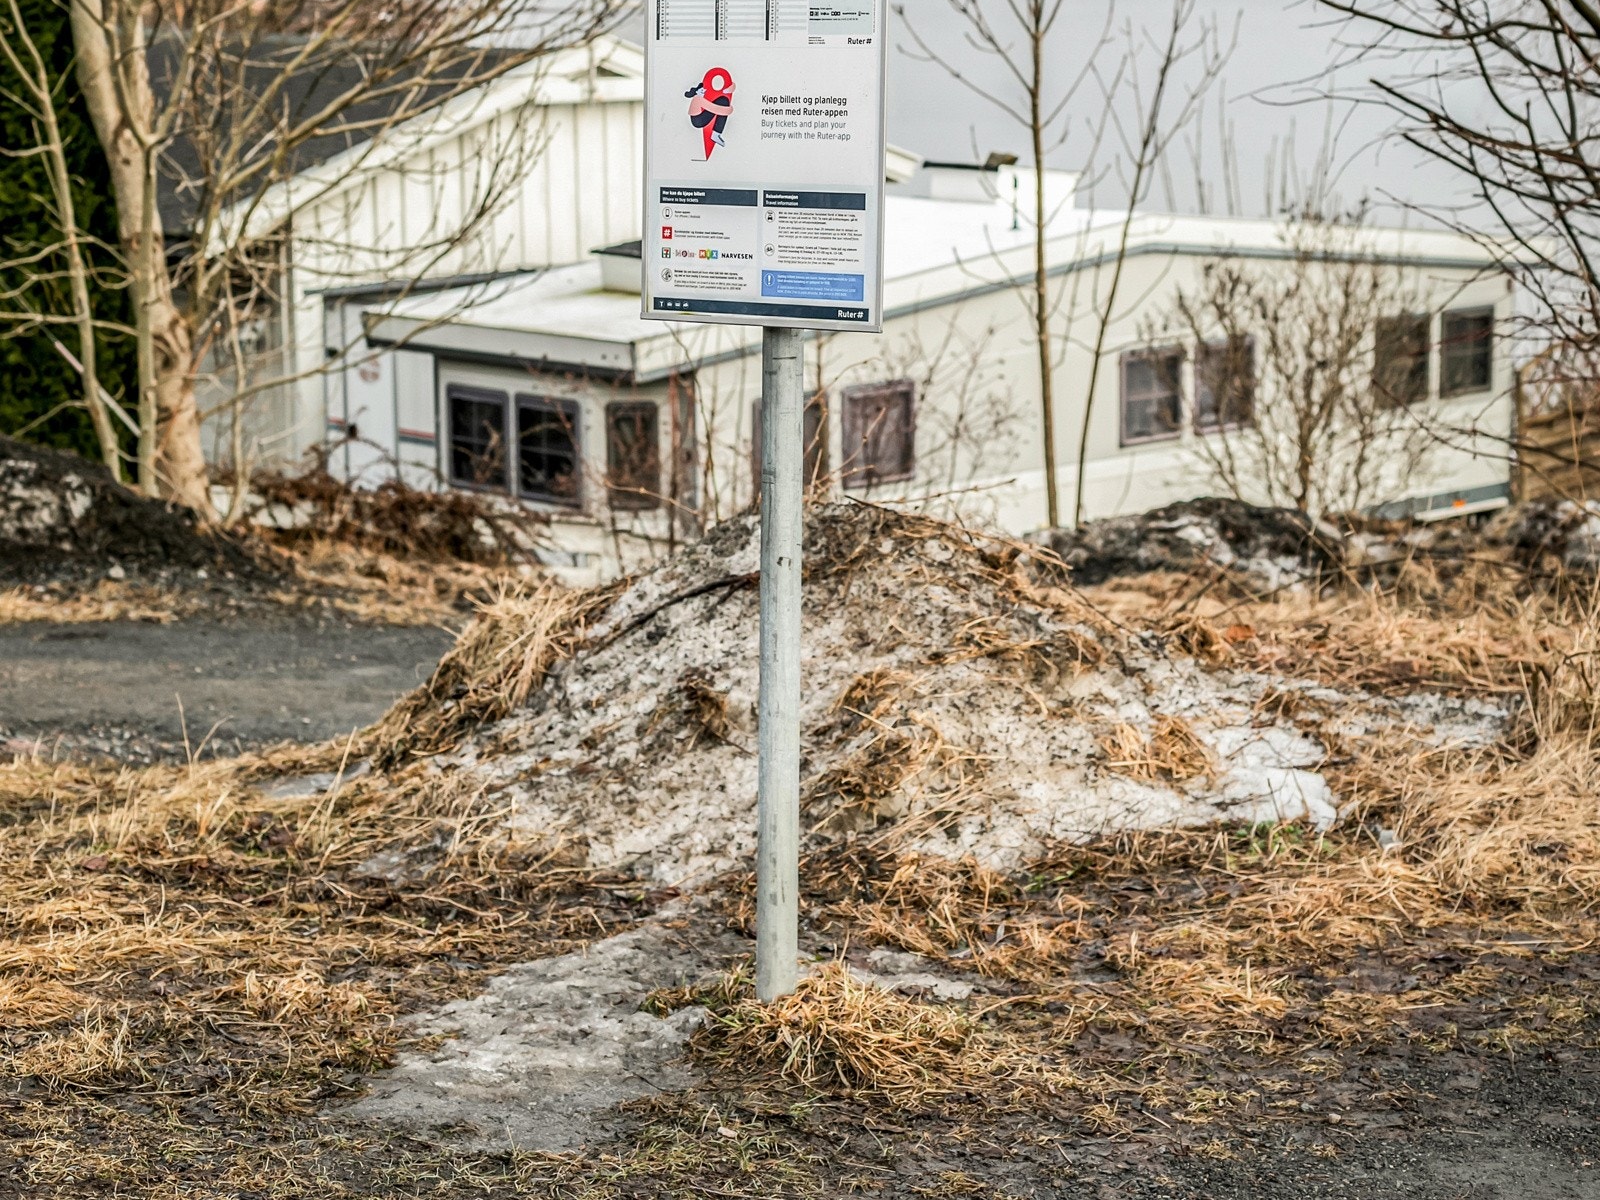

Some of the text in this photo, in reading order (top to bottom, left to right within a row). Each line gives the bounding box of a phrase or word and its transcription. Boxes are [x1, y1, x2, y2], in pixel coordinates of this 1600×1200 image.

[761, 95, 847, 106] Kjøp billett og planlegg
[761, 107, 783, 115] reisen
[803, 108, 848, 117] Ruter-appen
[761, 120, 774, 128] Buy
[814, 121, 828, 129] plan
[761, 132, 786, 140] journey
[817, 132, 851, 141] Ruter-app
